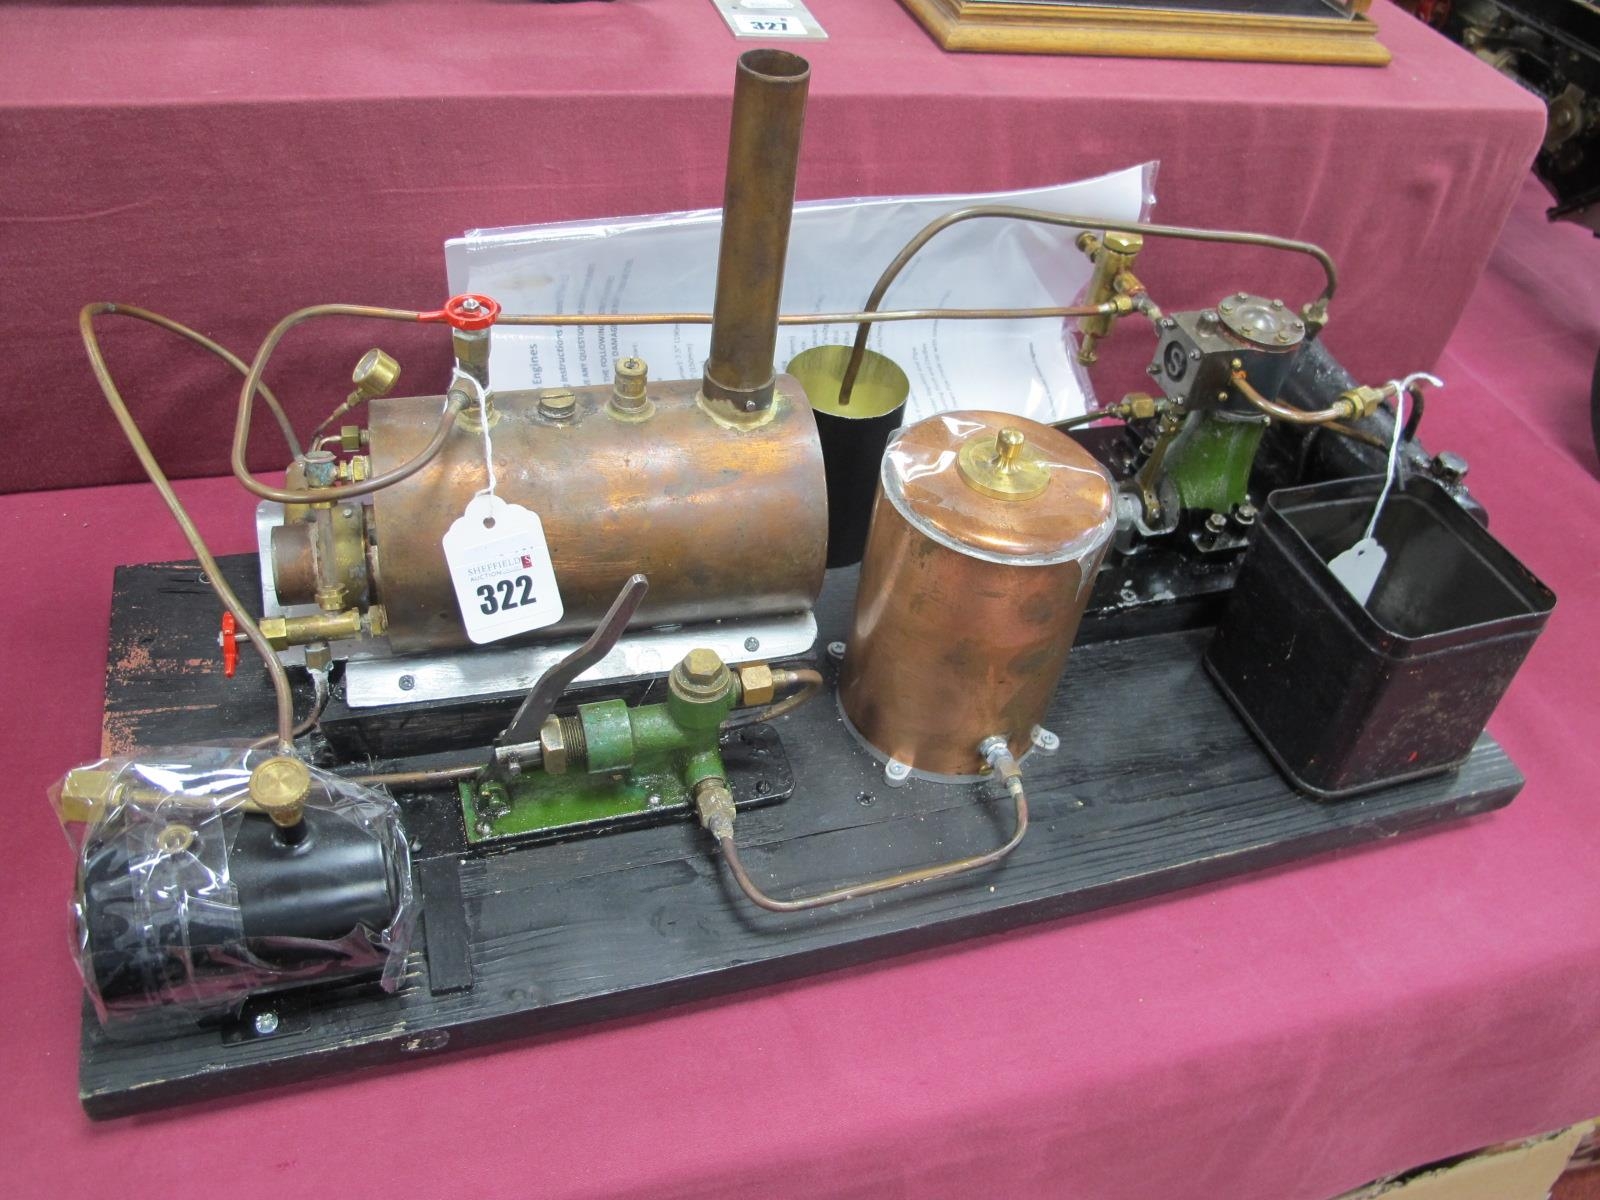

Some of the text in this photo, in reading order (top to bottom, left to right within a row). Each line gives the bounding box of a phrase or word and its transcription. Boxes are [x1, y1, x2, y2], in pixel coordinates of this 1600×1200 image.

[529, 343, 543, 385] Engines
[467, 556, 521, 576] SHEFFIELD
[470, 571, 502, 582] AUCTION
[476, 575, 537, 616] 322
